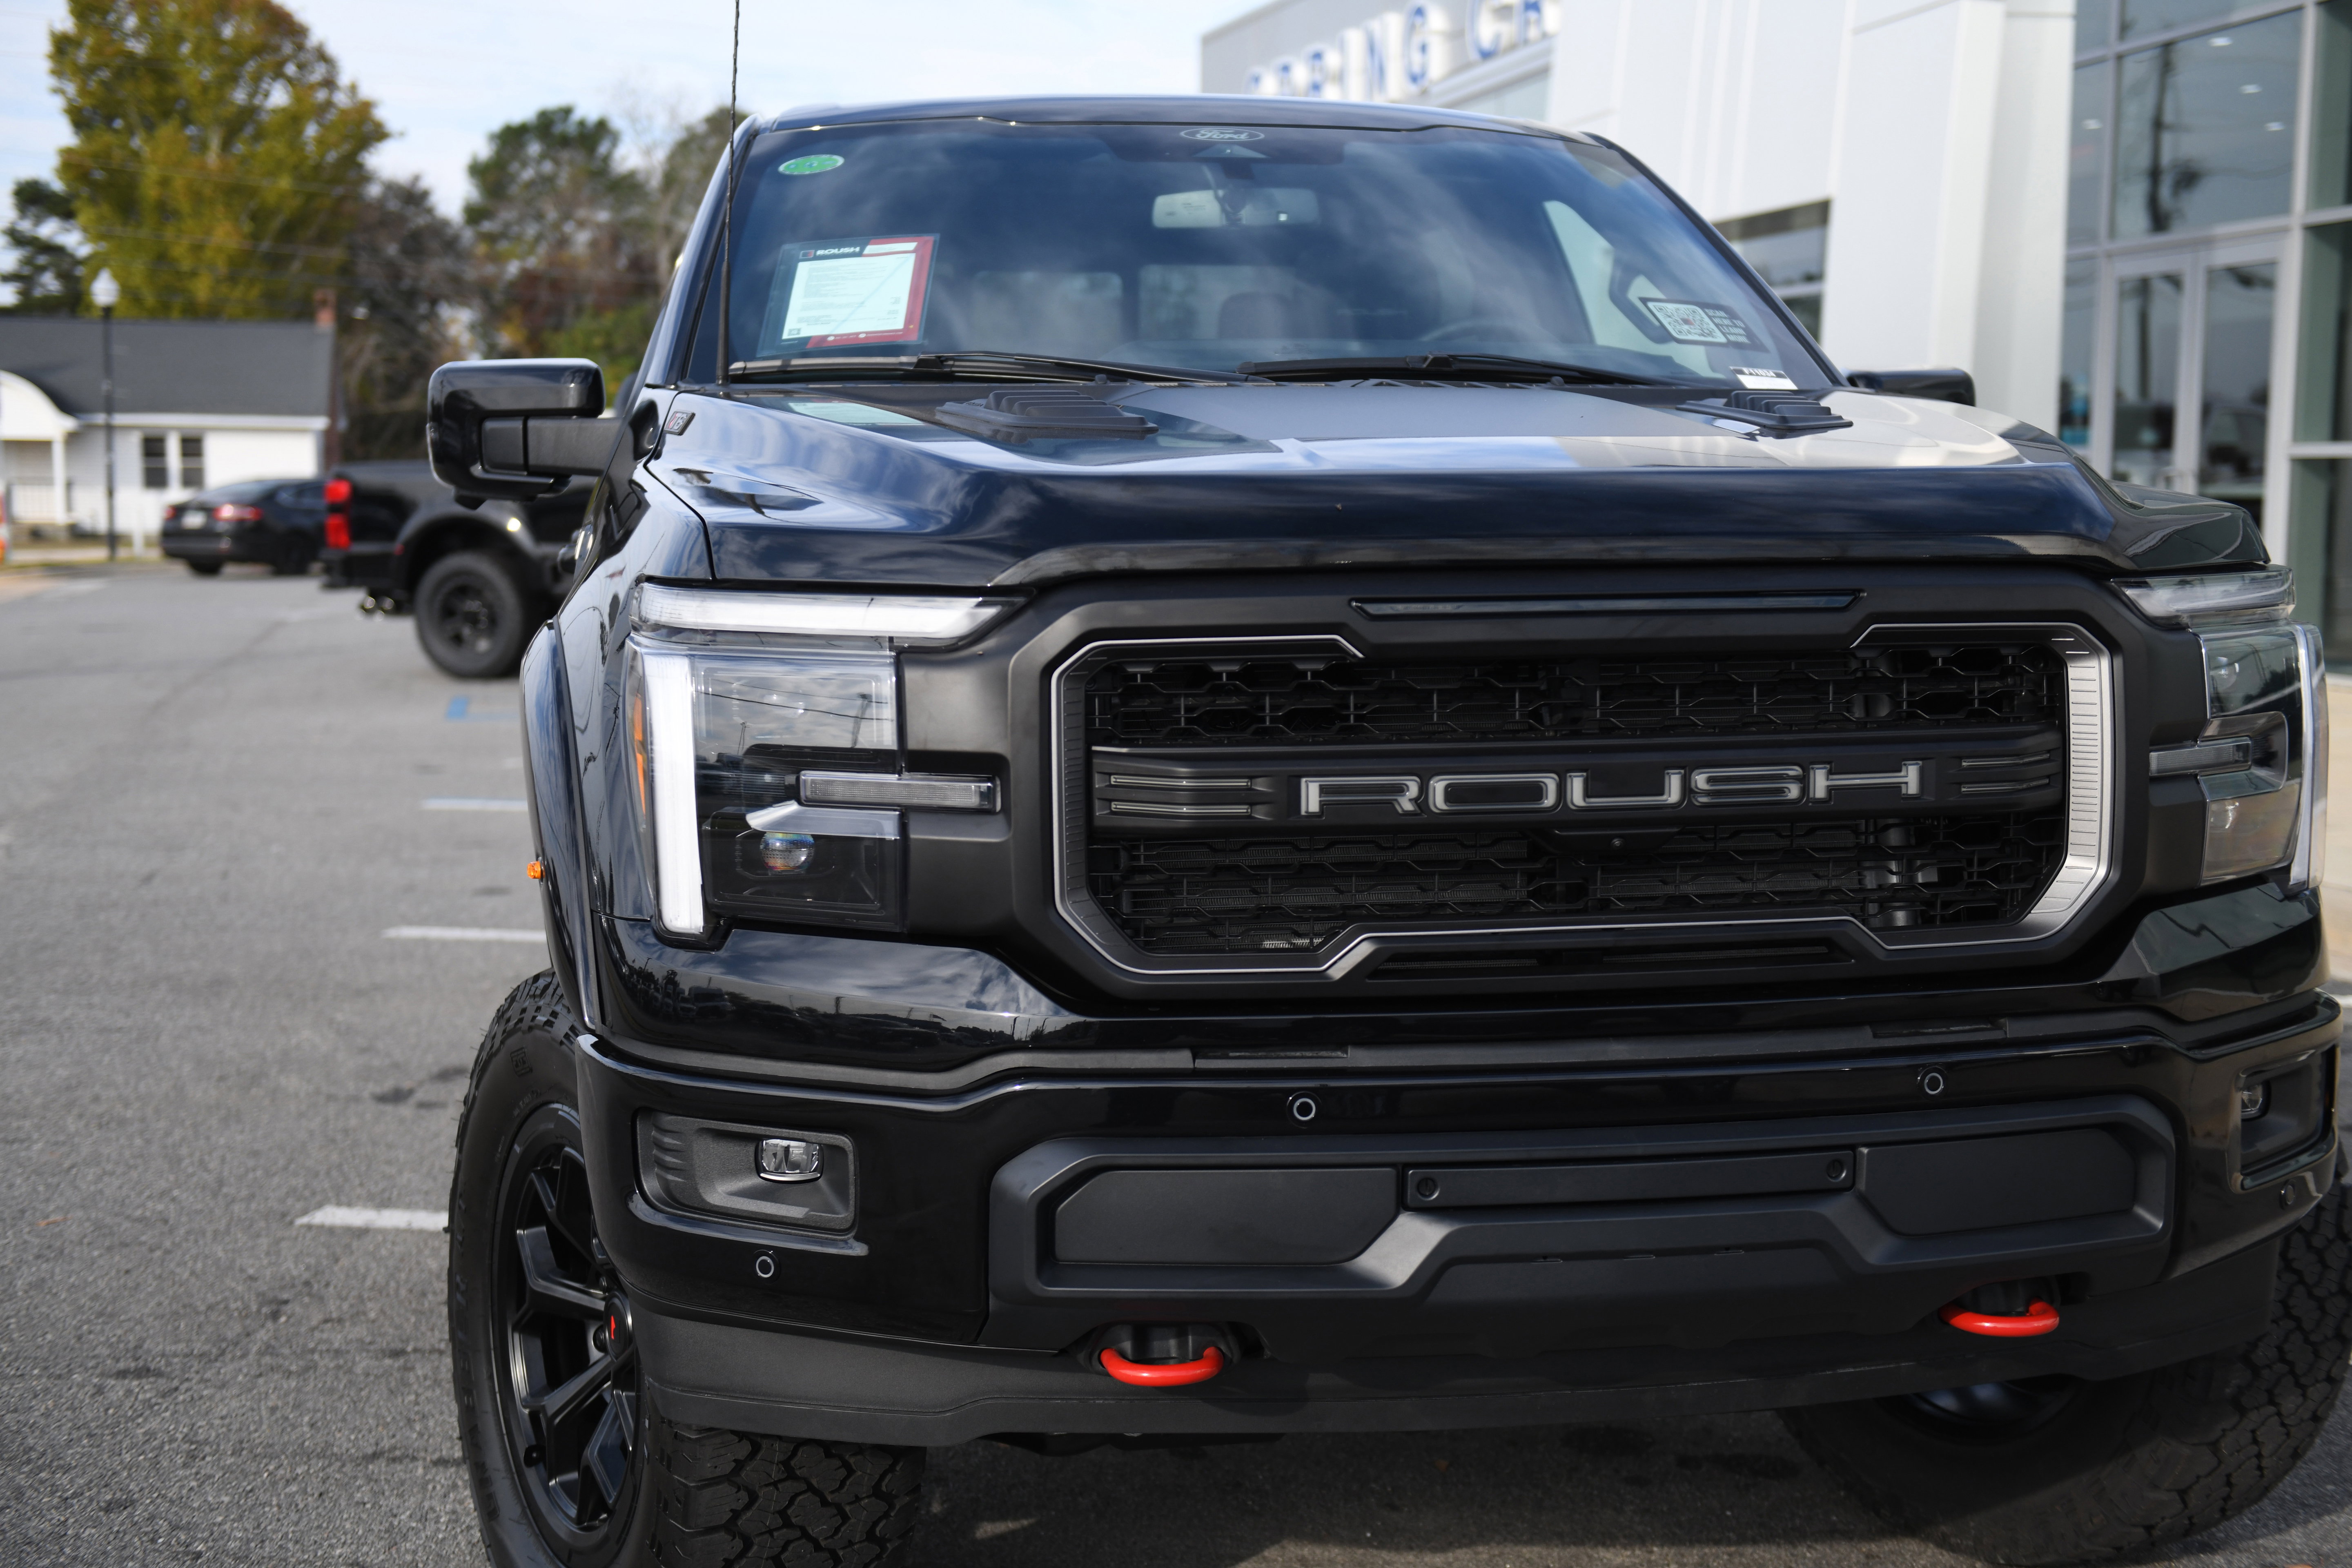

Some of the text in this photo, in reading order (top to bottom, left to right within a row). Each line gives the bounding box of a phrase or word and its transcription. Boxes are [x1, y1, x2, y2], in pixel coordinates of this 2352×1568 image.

[1196, 129, 1250, 139] Ford
[816, 247, 860, 256] ROUSH
[1704, 308, 1728, 318] SCAN
[1711, 317, 1745, 327] HERE TO
[1718, 325, 1747, 335] LEARN
[1725, 333, 1751, 343] MORE
[1299, 760, 1922, 816] ROUSH
